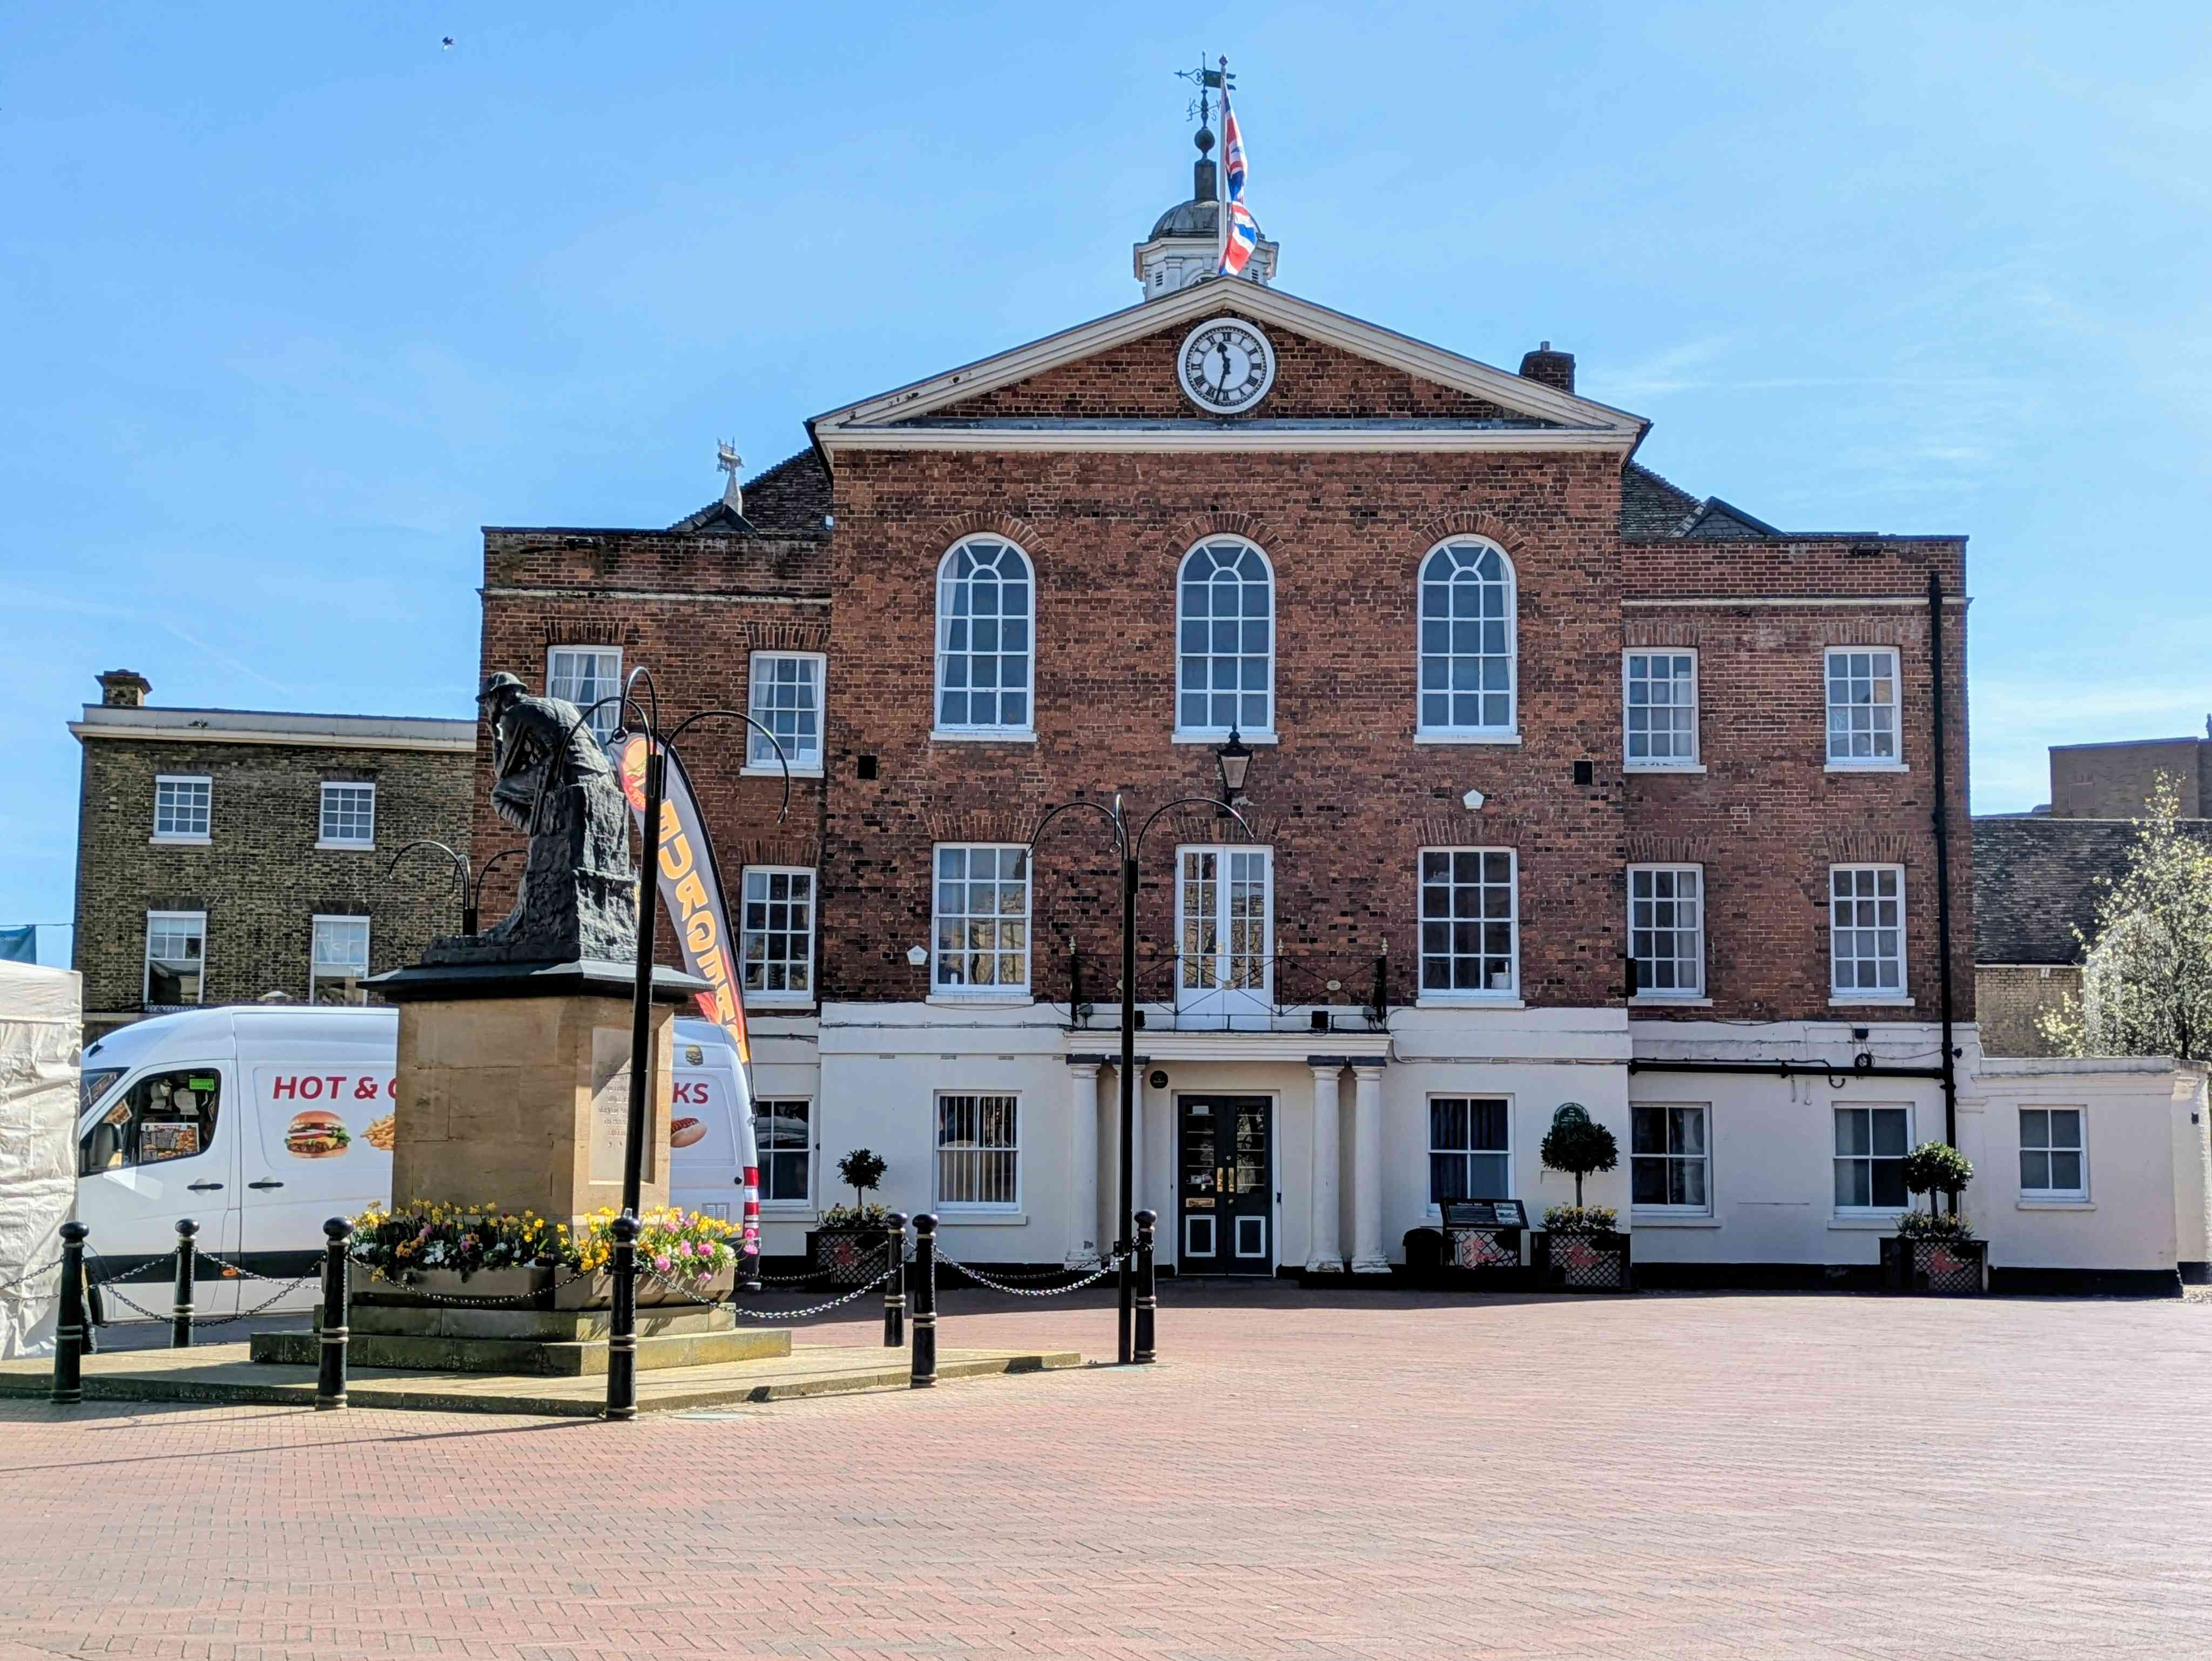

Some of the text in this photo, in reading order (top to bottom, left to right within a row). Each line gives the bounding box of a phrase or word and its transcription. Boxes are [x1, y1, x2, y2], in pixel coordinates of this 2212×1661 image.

[1222, 332, 1231, 341] XII
[273, 1076, 347, 1099] HOT
[354, 1076, 378, 1099] &
